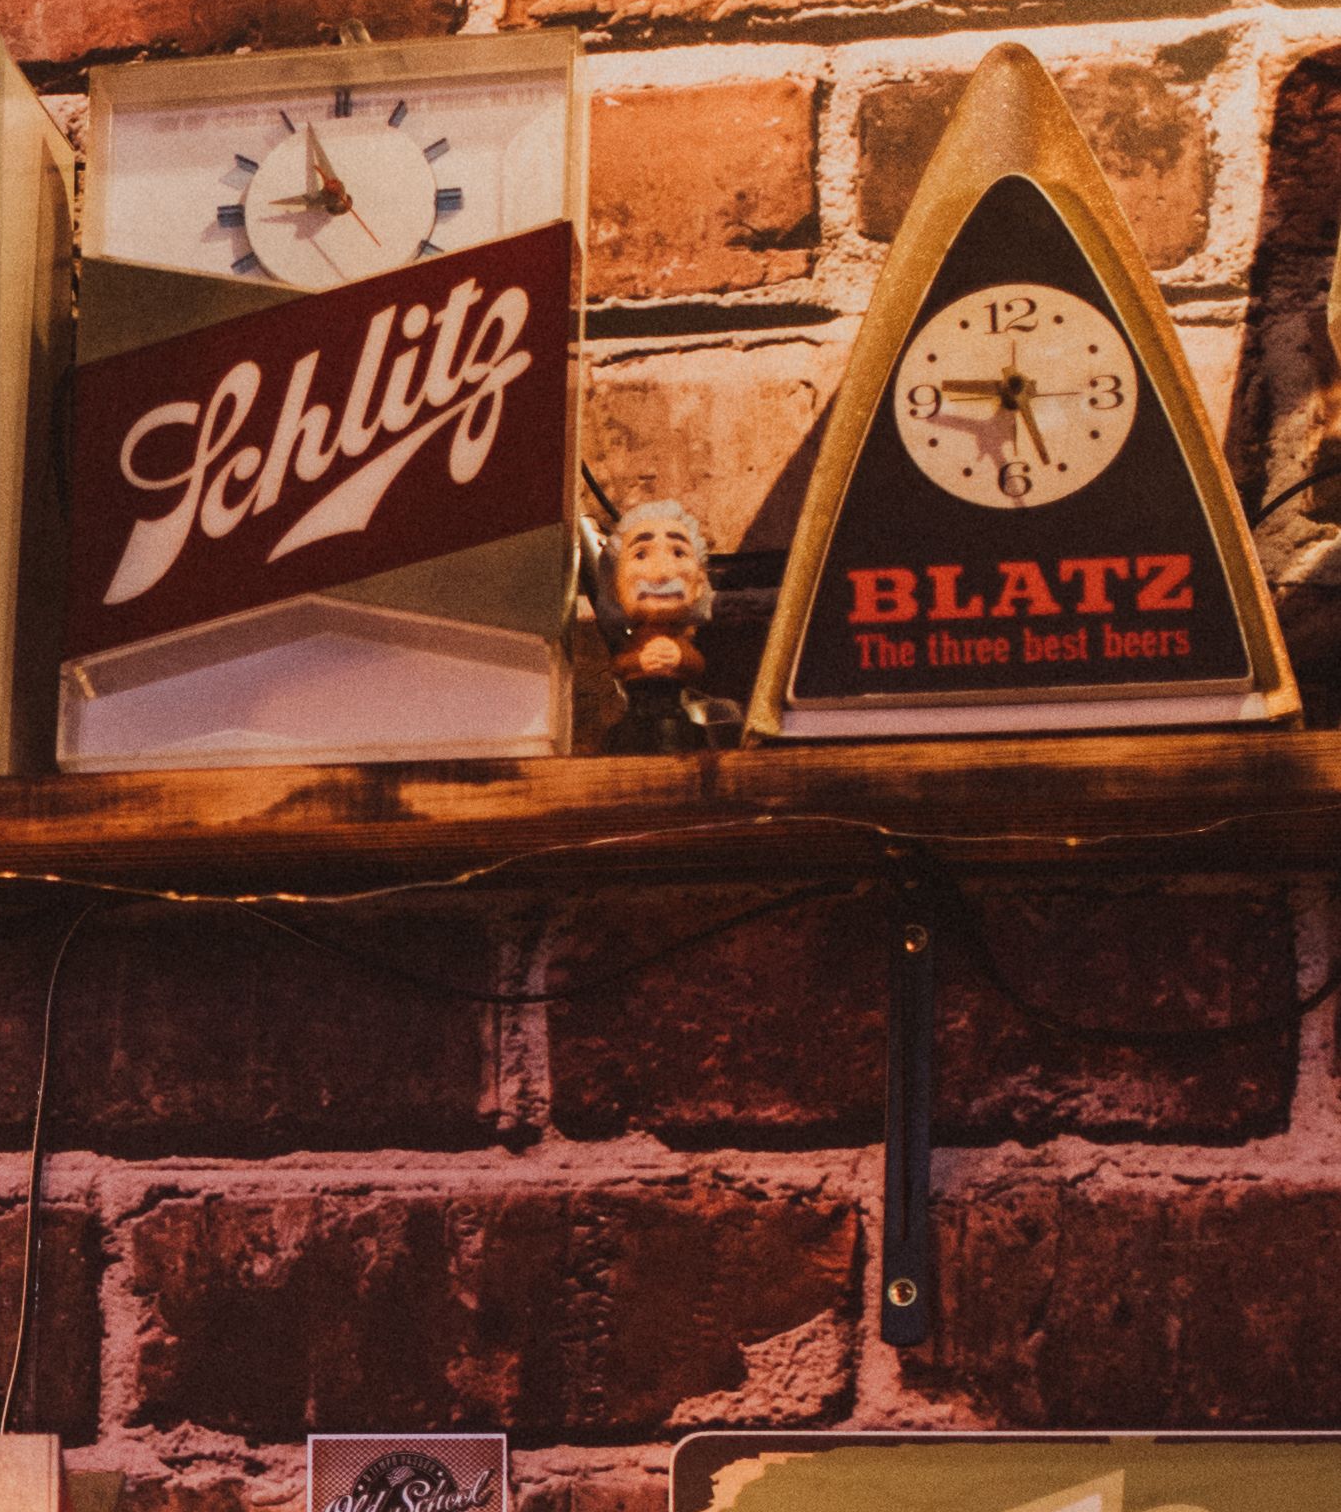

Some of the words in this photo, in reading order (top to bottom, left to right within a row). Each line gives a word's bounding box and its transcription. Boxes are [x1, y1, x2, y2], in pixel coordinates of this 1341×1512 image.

[981, 298, 1038, 337] 12
[906, 385, 942, 419] 9
[1087, 374, 1123, 410] 3
[103, 277, 533, 605] Schlitz
[997, 461, 1033, 497] 6
[846, 553, 1194, 624] BLATZ
[855, 631, 917, 670] The
[926, 627, 1011, 666] three
[1023, 626, 1089, 661] best
[1103, 627, 1191, 659] beers
